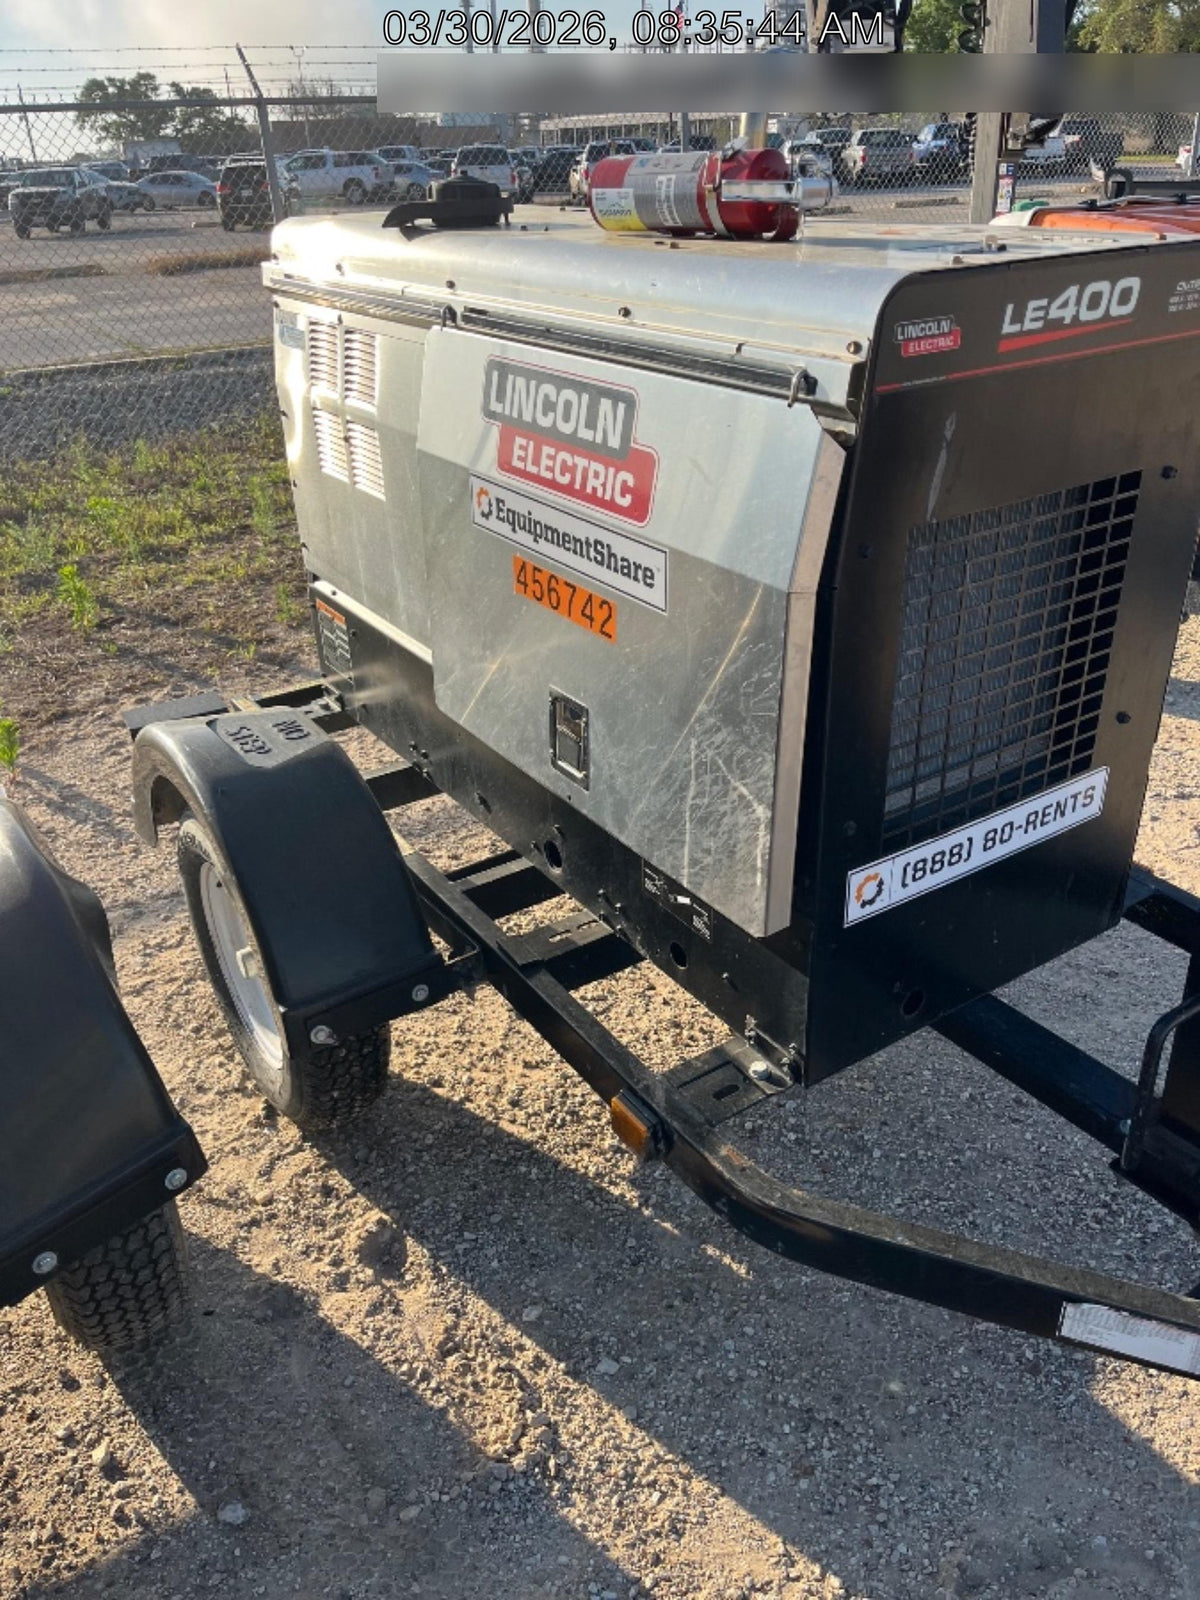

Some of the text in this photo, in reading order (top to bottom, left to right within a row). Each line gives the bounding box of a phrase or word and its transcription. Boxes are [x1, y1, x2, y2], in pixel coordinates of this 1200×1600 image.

[896, 318, 951, 341] LINCOLN
[1002, 276, 1141, 334] LE400
[908, 334, 955, 353] ELECTRIC
[489, 370, 627, 451] LINCOLN
[510, 435, 636, 508] ELECTRIC
[495, 498, 656, 590] EquipmentShare
[515, 560, 614, 640] 456742
[982, 785, 1097, 853] 80-RENTS
